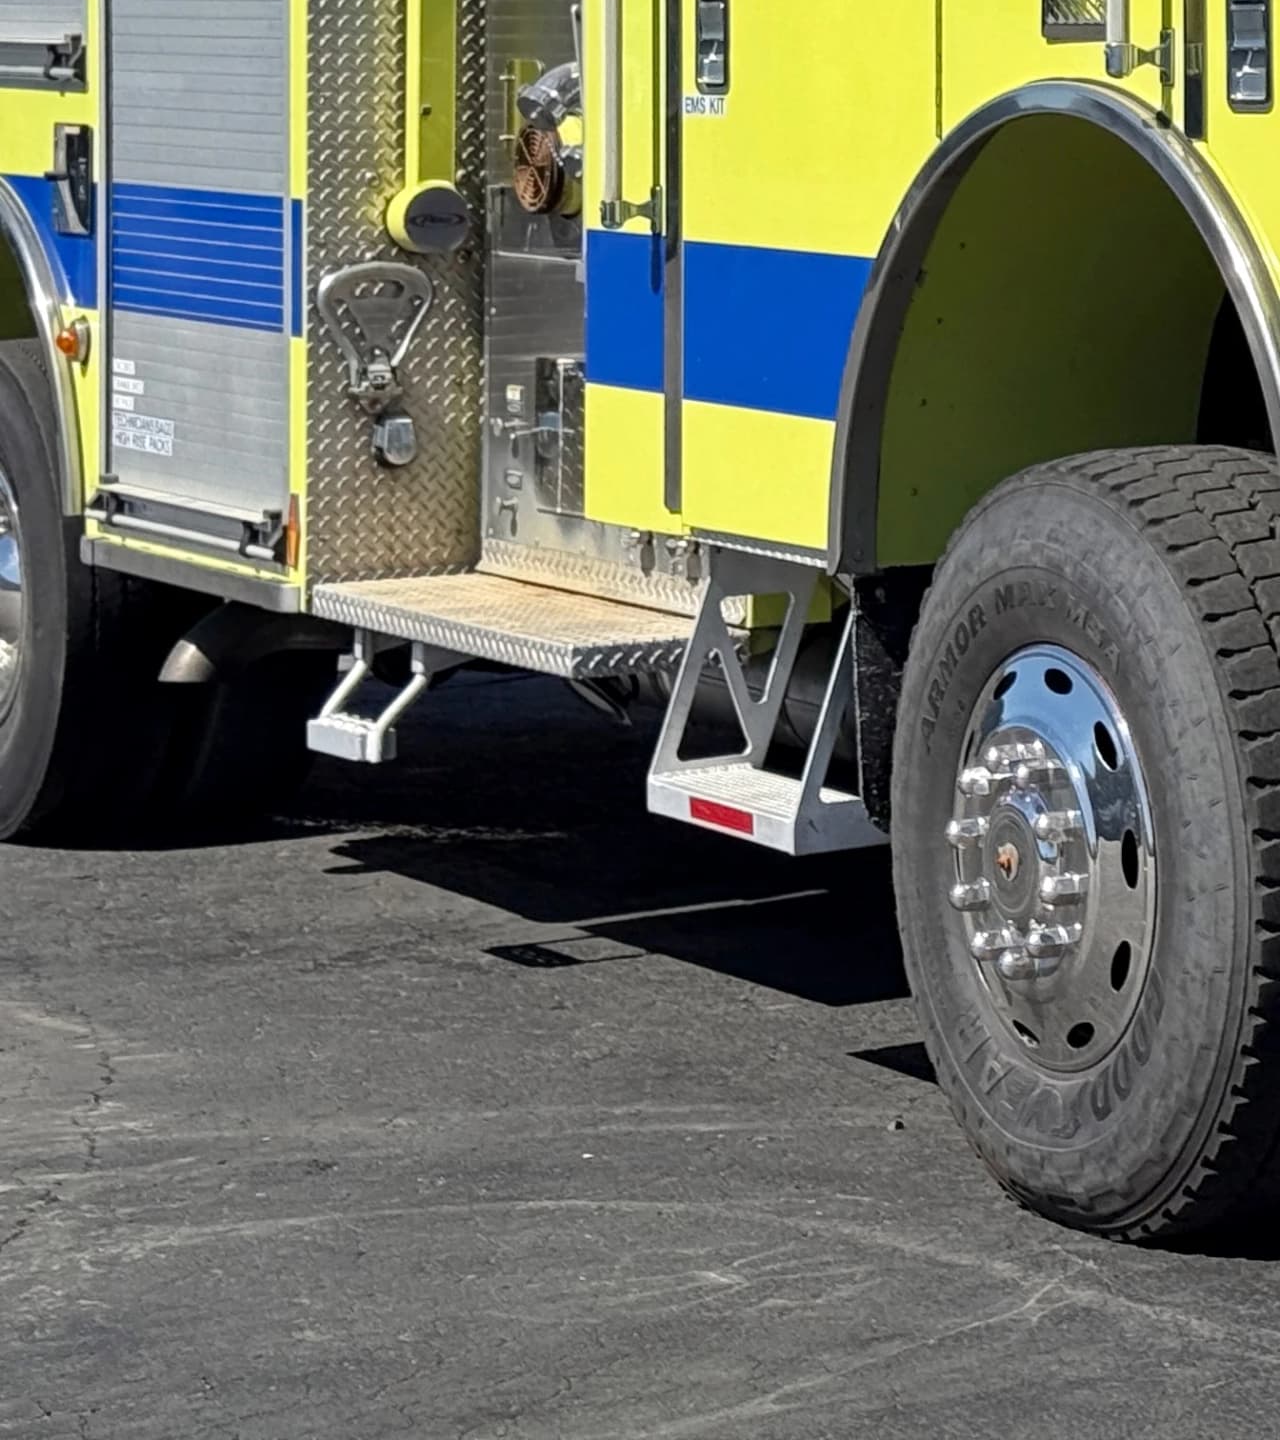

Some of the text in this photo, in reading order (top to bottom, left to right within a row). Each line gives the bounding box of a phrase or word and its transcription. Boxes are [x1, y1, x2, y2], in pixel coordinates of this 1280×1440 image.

[685, 95, 725, 115] EMS KIT
[921, 604, 988, 755] ARMOR
[993, 581, 1057, 616] MAX
